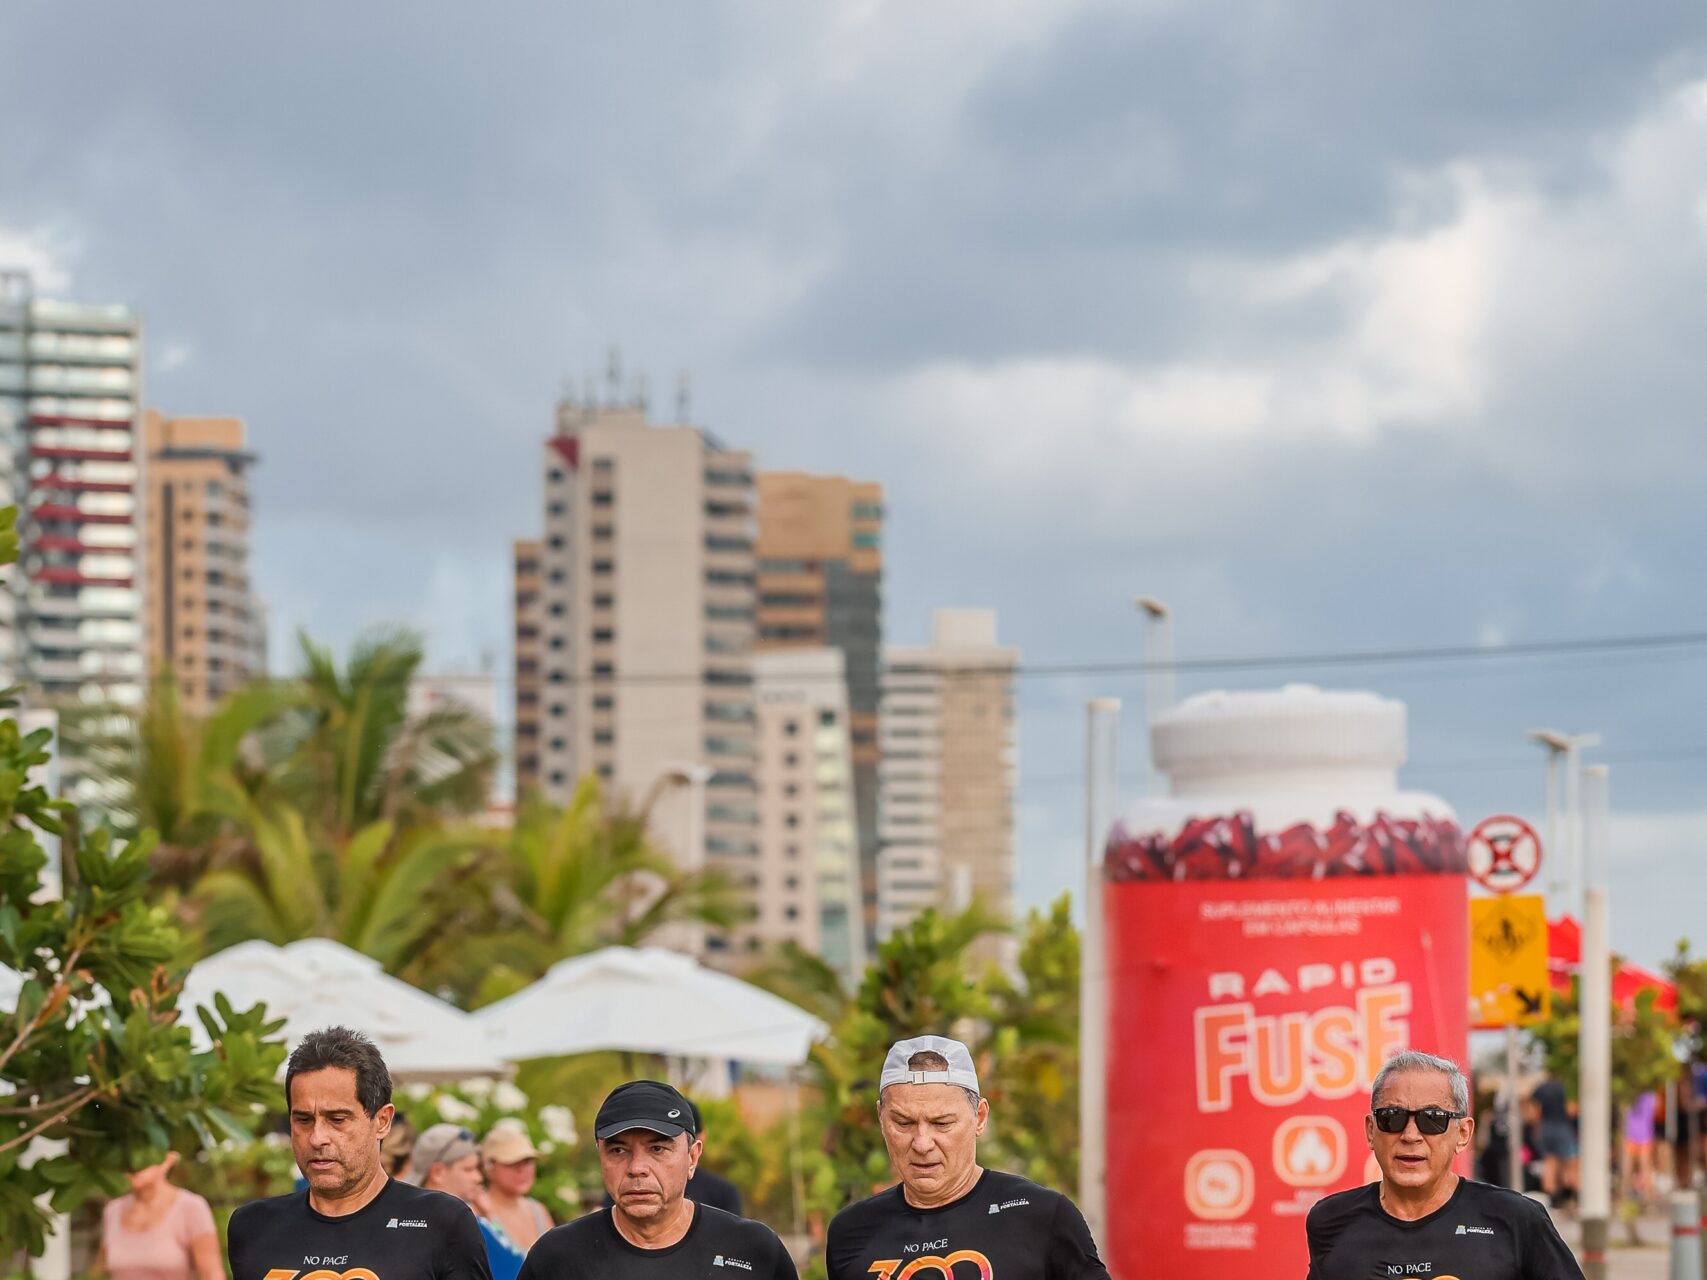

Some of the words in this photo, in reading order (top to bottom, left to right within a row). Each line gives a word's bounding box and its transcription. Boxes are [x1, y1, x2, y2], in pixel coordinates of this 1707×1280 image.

[1208, 957, 1396, 1000] RAPID
[1194, 982, 1412, 1112] FUSE
[904, 1244, 919, 1253] NO
[922, 1239, 948, 1252] PACE
[303, 1256, 320, 1265] NO
[322, 1255, 348, 1265] PACE
[1387, 1265, 1403, 1275] NO
[1406, 1262, 1432, 1274] PACE
